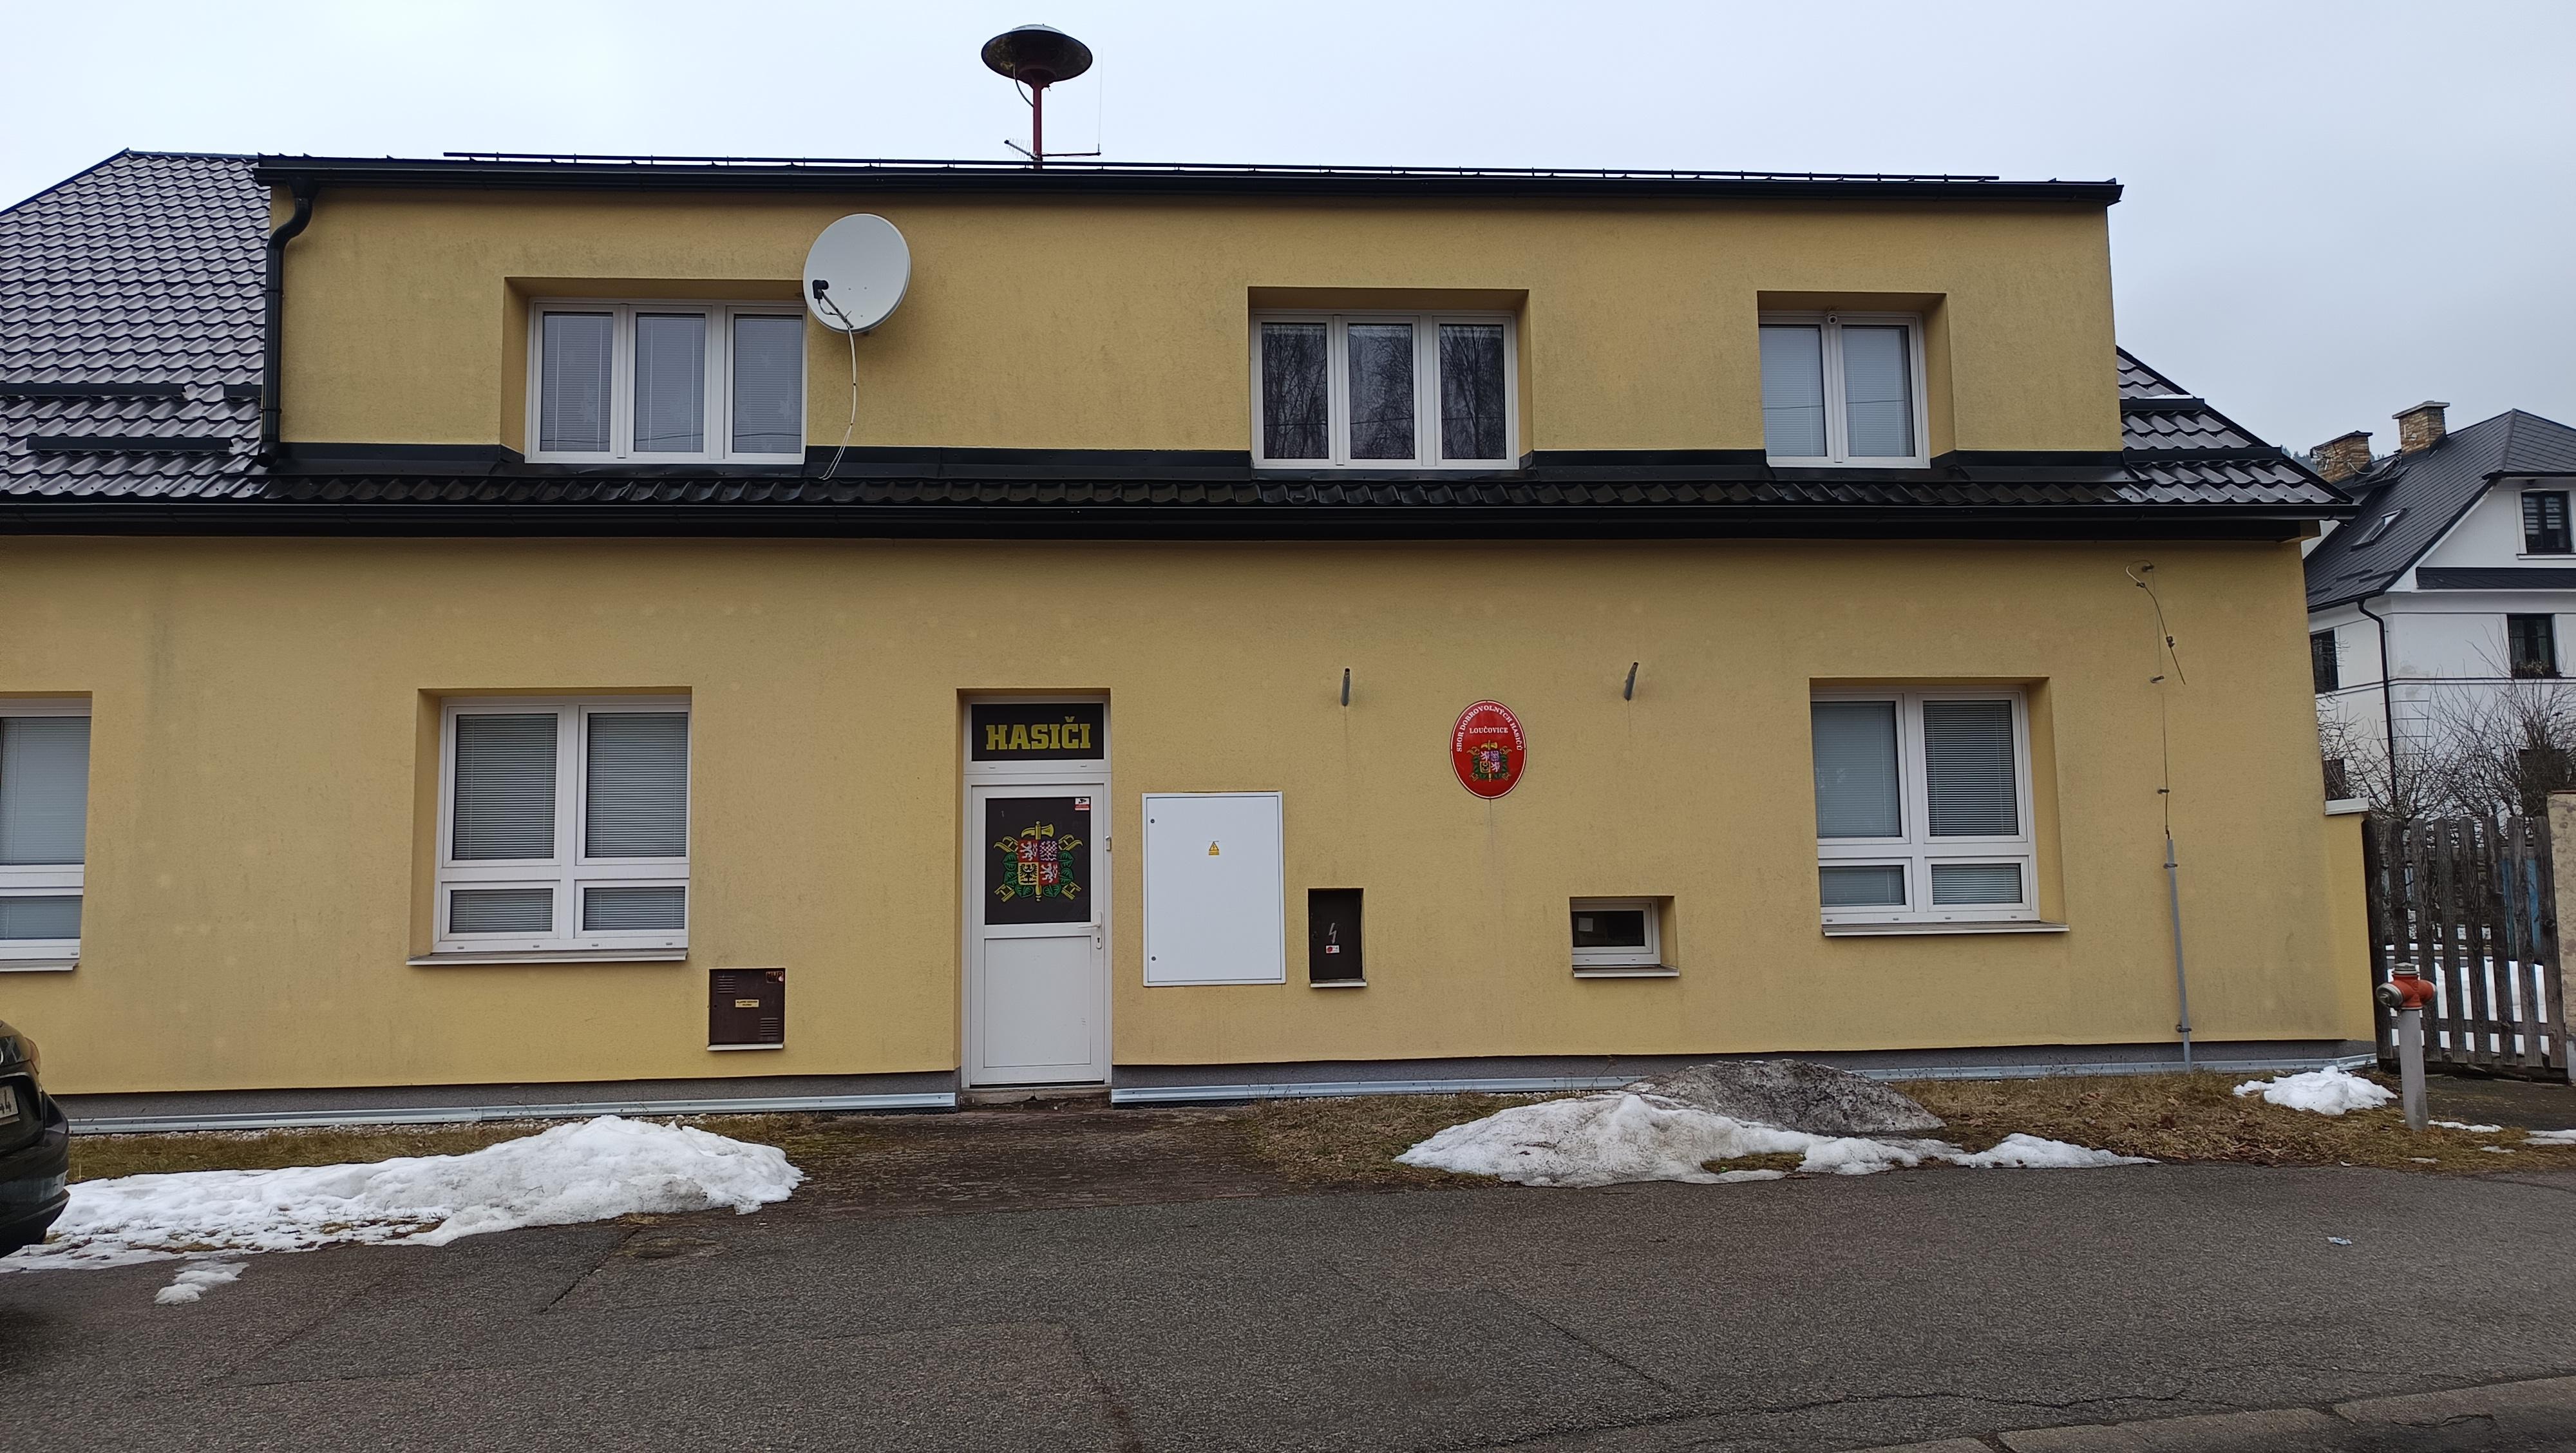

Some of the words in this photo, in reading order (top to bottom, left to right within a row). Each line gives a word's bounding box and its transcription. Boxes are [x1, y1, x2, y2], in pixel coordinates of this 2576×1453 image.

[986, 716, 1091, 750] HASIČI
[1459, 705, 1513, 730] DOBROVOLNÝCH
[1510, 723, 1523, 751] HASIČŮ
